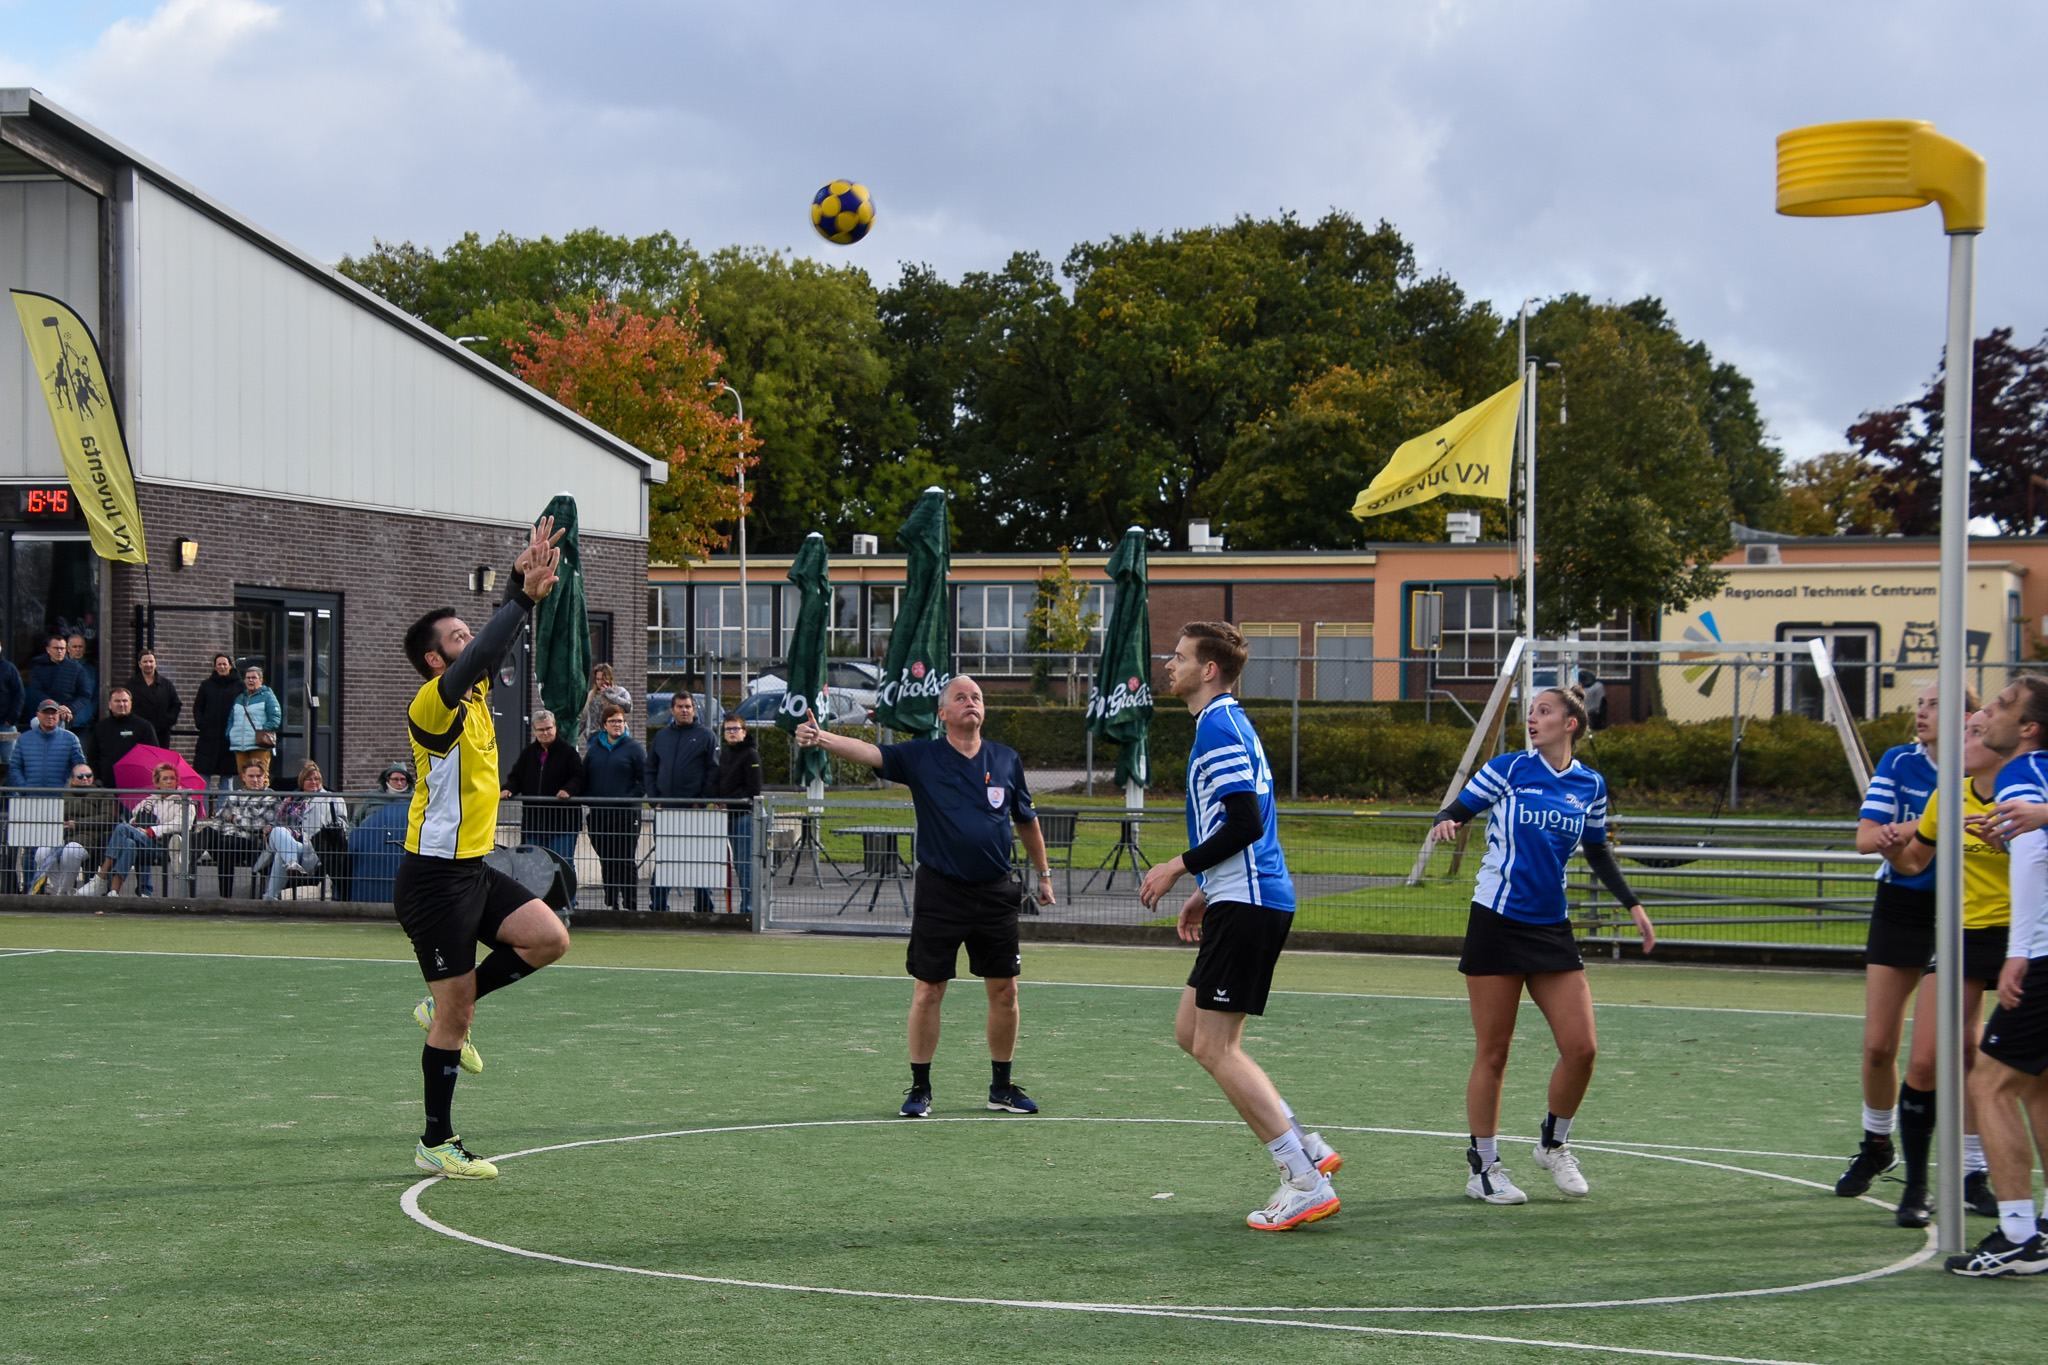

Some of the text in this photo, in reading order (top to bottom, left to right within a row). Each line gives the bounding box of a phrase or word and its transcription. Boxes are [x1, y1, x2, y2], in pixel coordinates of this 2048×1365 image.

[28, 490, 68, 512] 15:45
[1725, 584, 1937, 600] Regionaal Techniek Centrum
[1518, 803, 1581, 834] bijont
